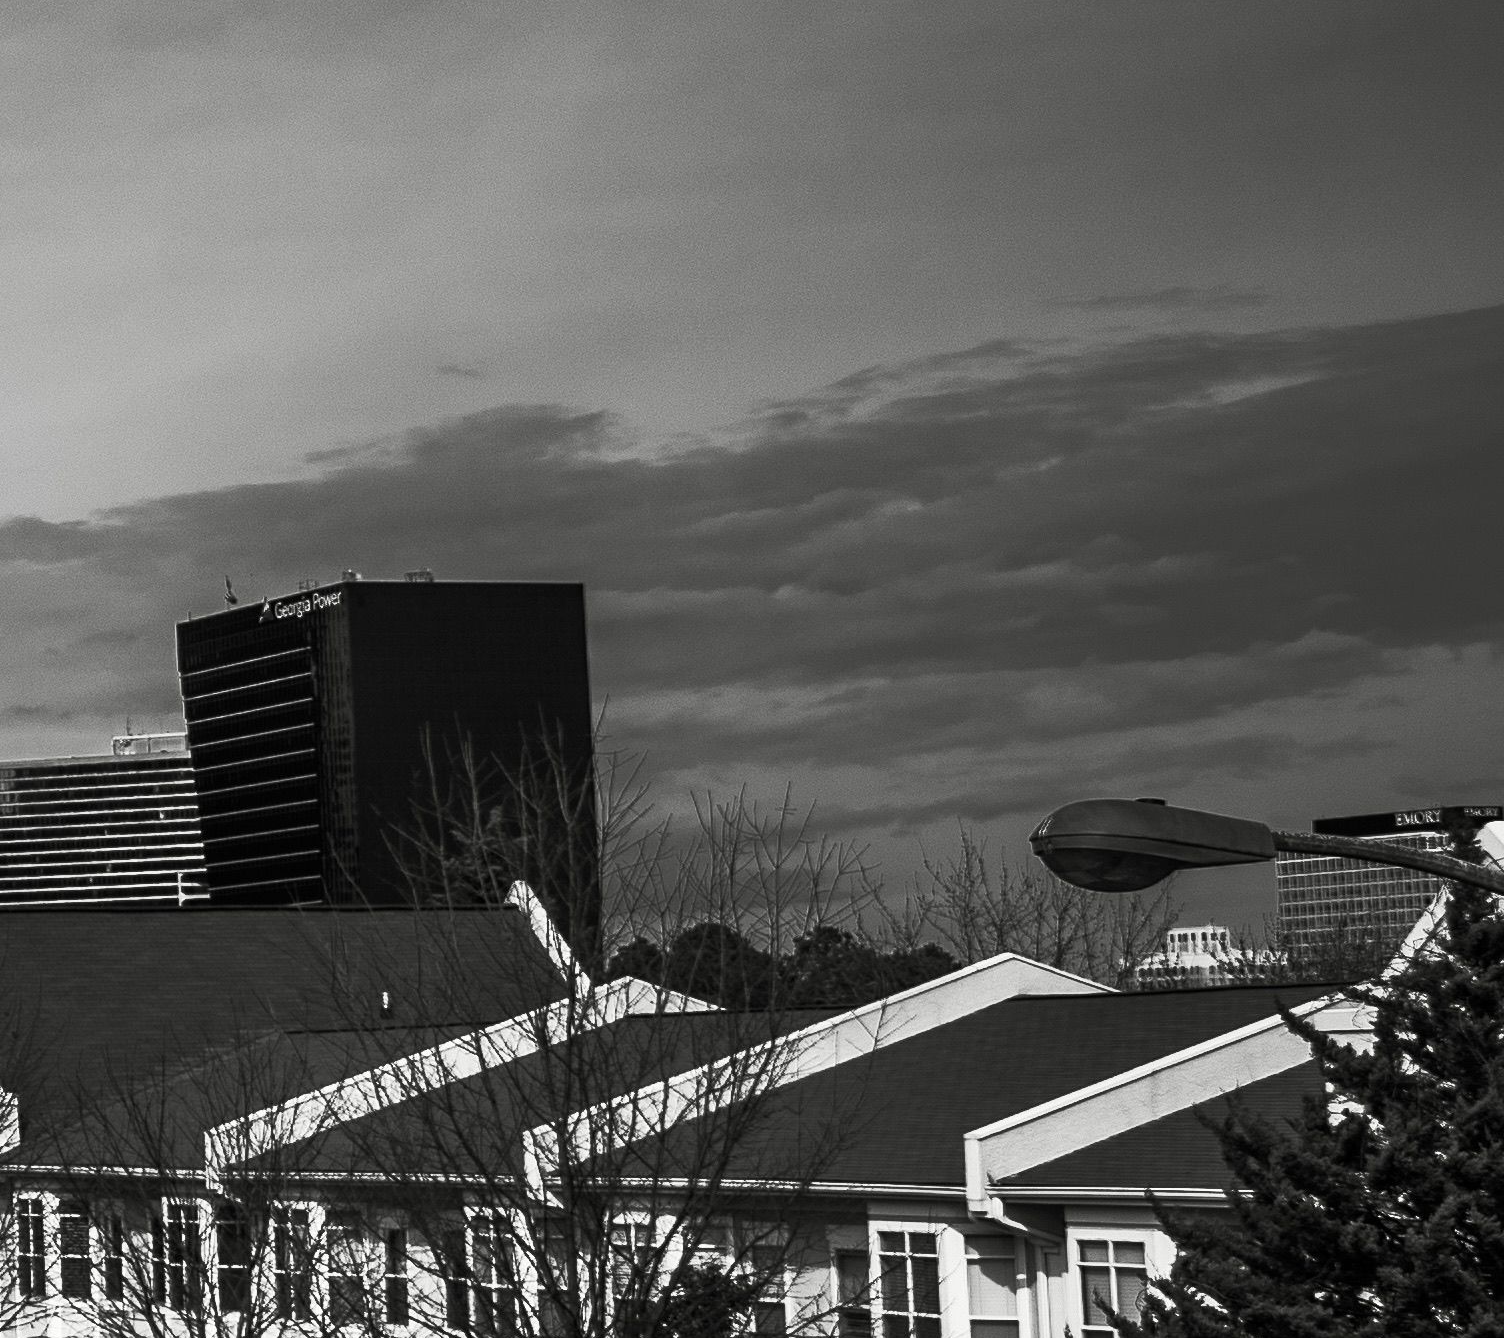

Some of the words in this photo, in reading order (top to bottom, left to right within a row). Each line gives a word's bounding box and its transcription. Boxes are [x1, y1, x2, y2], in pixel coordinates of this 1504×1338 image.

[275, 596, 311, 619] Georgia
[313, 592, 342, 610] Power
[1396, 810, 1441, 826] EMORY
